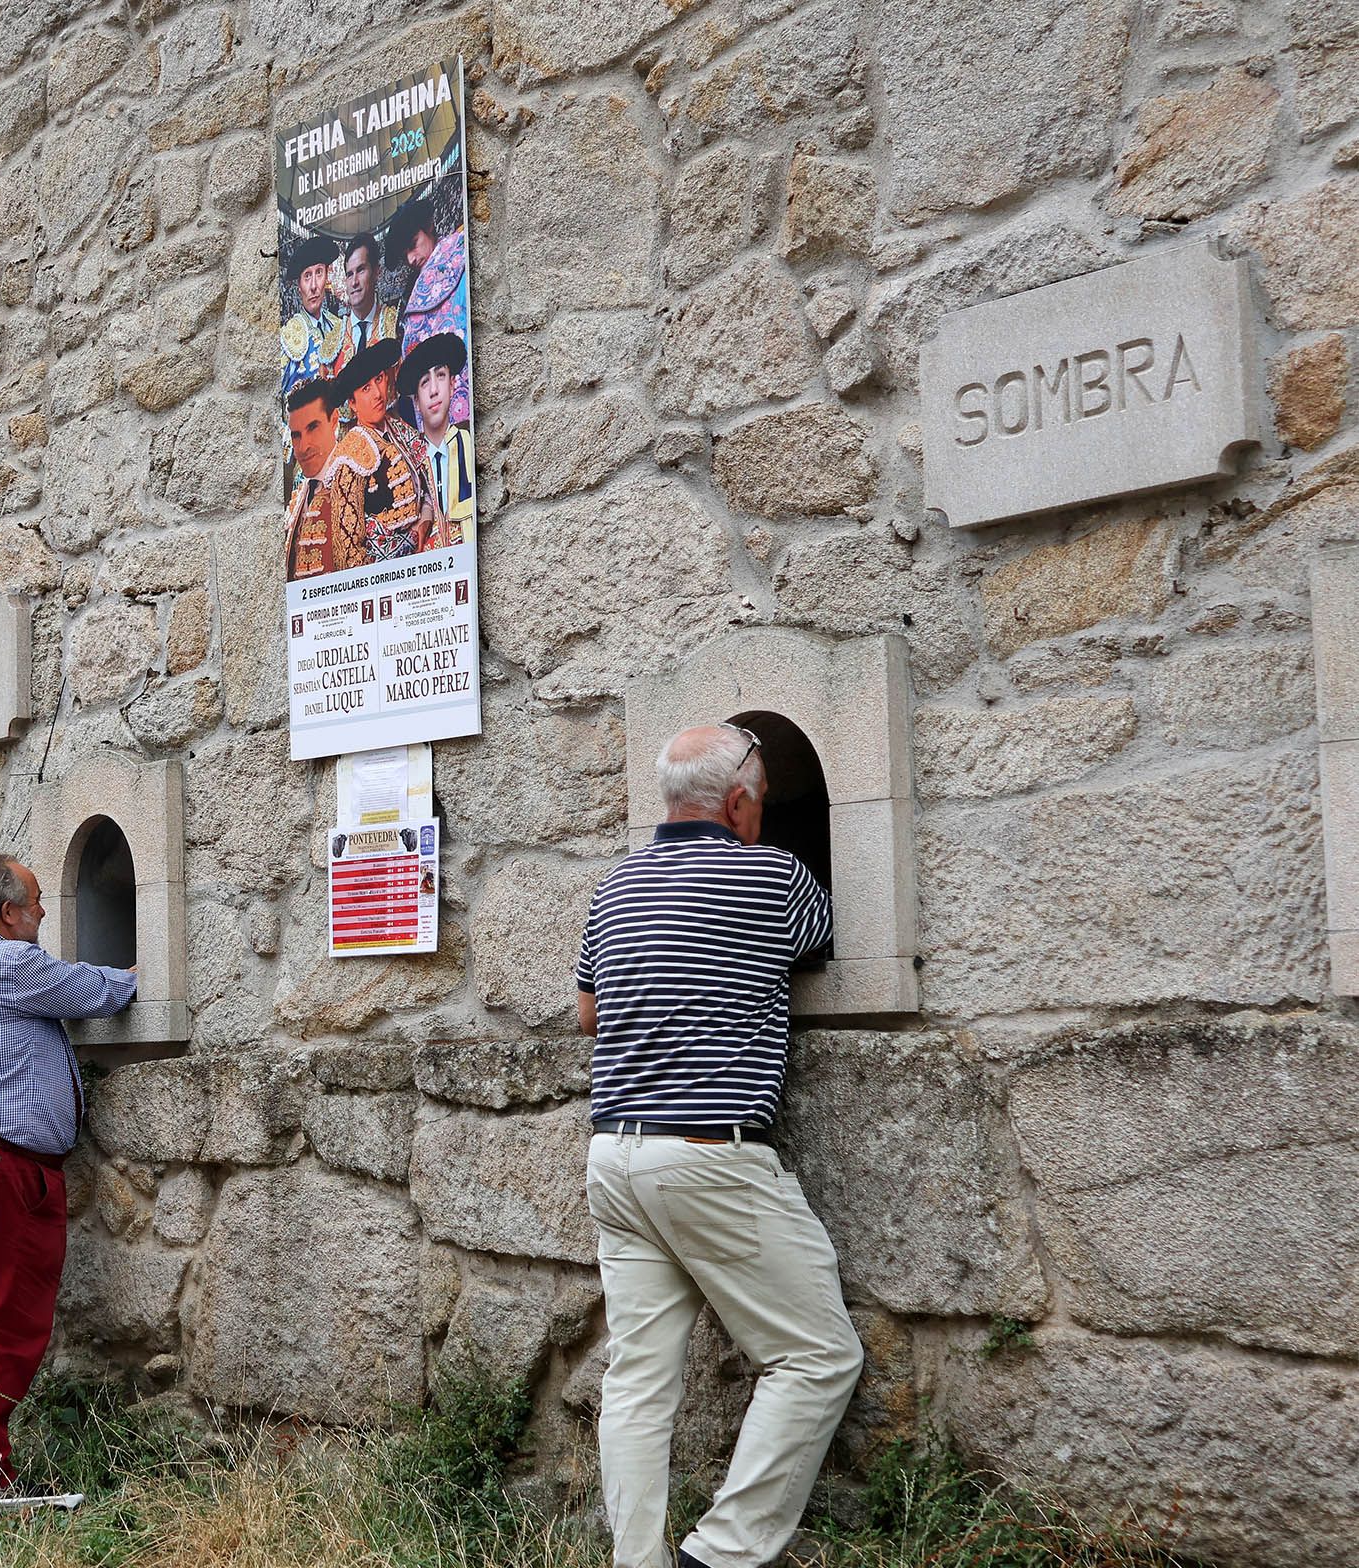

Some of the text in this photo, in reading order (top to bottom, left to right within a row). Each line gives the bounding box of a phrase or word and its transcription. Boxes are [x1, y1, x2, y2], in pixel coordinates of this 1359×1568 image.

[285, 74, 452, 168] FERIA TAURINA
[391, 127, 424, 158] 2026
[298, 145, 379, 196] DE LA PEREGRINA
[296, 157, 442, 226] Plaza de toros de Pontevedra
[954, 332, 1202, 449] SOMBRA
[302, 588, 308, 600] 2
[309, 579, 368, 598] ESPECTACULARES
[370, 571, 405, 586] CORRIDAS
[407, 567, 416, 578] DE
[448, 556, 454, 568] 2
[396, 582, 452, 602] CORRIDA DE TOROS
[459, 586, 464, 600] 7
[307, 602, 358, 622] CORRIDA DE TOROS
[365, 606, 370, 619] 7
[384, 602, 388, 615] 9
[294, 621, 300, 633] 8
[382, 624, 469, 657] ALEJANDRO TALAVANTE
[298, 642, 370, 672] DIEGO URDIALES
[396, 649, 458, 677] ROCA REY
[322, 664, 376, 690] CASTELLA
[386, 670, 470, 703] MARCO PÉREZ
[305, 690, 364, 716] DANIEL LUQUE
[348, 831, 398, 846] PONTEVEDRA
